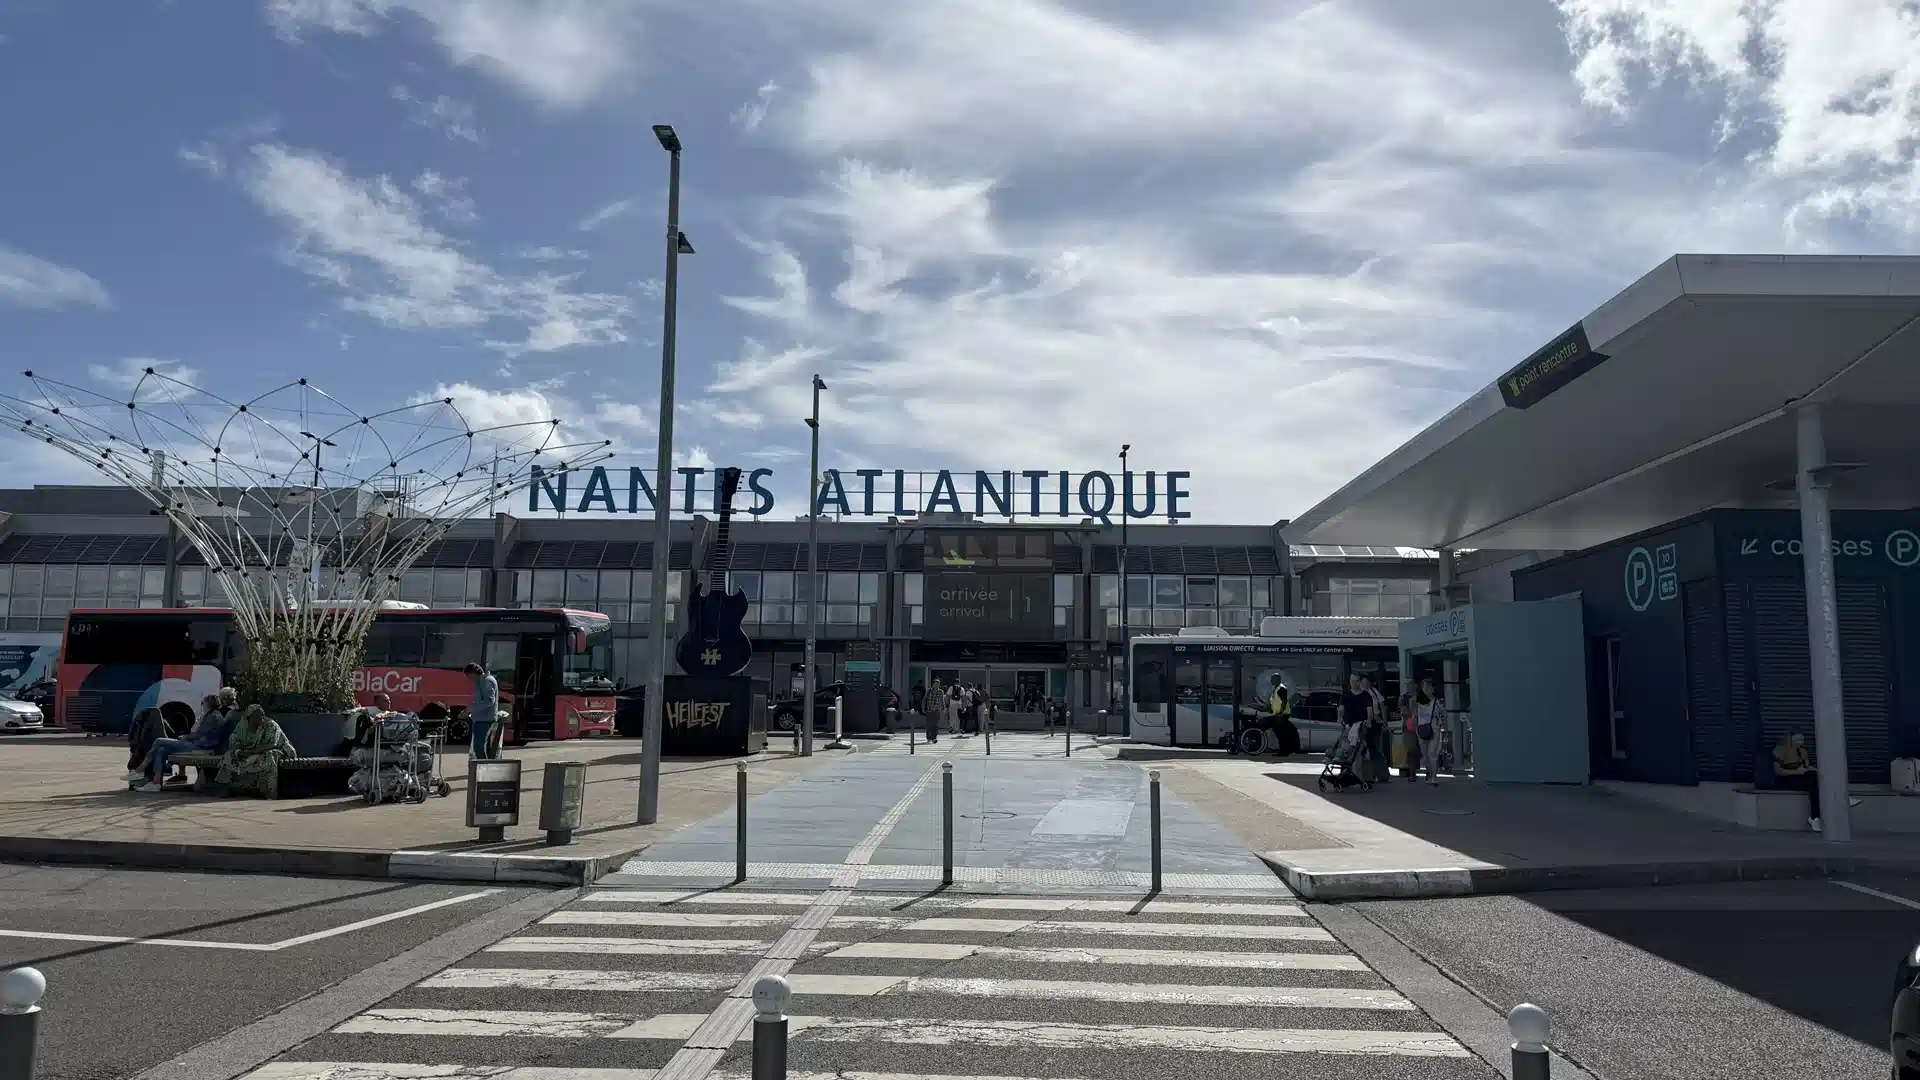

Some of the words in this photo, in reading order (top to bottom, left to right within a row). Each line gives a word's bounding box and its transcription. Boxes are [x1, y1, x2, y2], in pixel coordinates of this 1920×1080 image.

[1519, 365, 1539, 391] point
[1538, 341, 1578, 375] rencontre
[816, 468, 1191, 532] ATLANTIQUE
[1771, 539, 1873, 556] cases
[940, 586, 999, 601] arrivée
[940, 605, 985, 617] arrival
[1024, 596, 1031, 613] 1
[666, 698, 731, 729] HELLFEST
